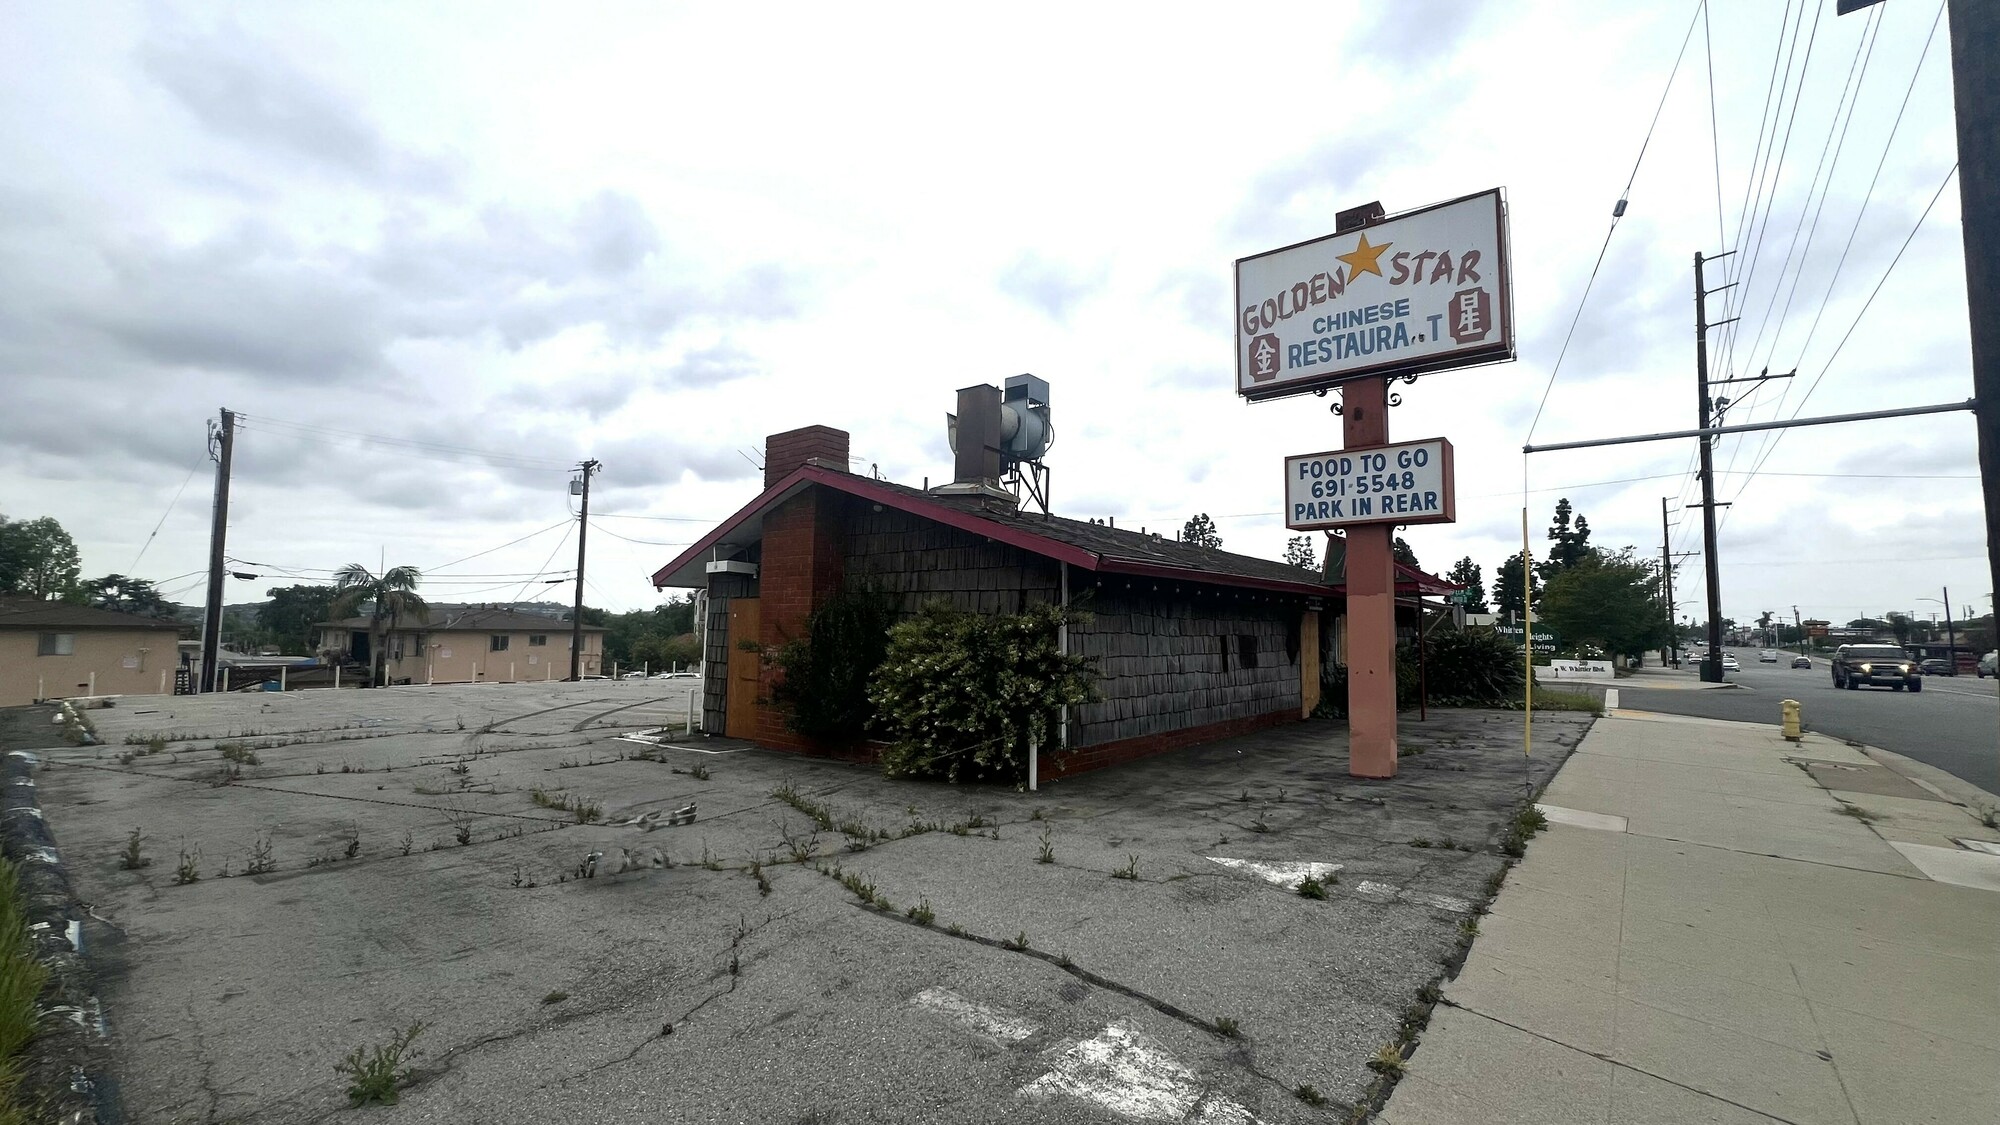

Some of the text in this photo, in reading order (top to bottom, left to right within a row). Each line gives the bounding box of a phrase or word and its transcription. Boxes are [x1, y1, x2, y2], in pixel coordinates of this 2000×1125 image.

[1242, 249, 1482, 336] GOLDEN STAR
[1312, 298, 1410, 335] CHINESE
[1457, 291, 1483, 336] 星
[1255, 342, 1276, 375] 金
[1288, 314, 1443, 370] RESTAURAT
[1299, 448, 1429, 480] FOOD TO GO
[1311, 471, 1415, 498] 691-5548
[1295, 491, 1438, 521] PARK IN REAR
[1529, 643, 1556, 652] Living
